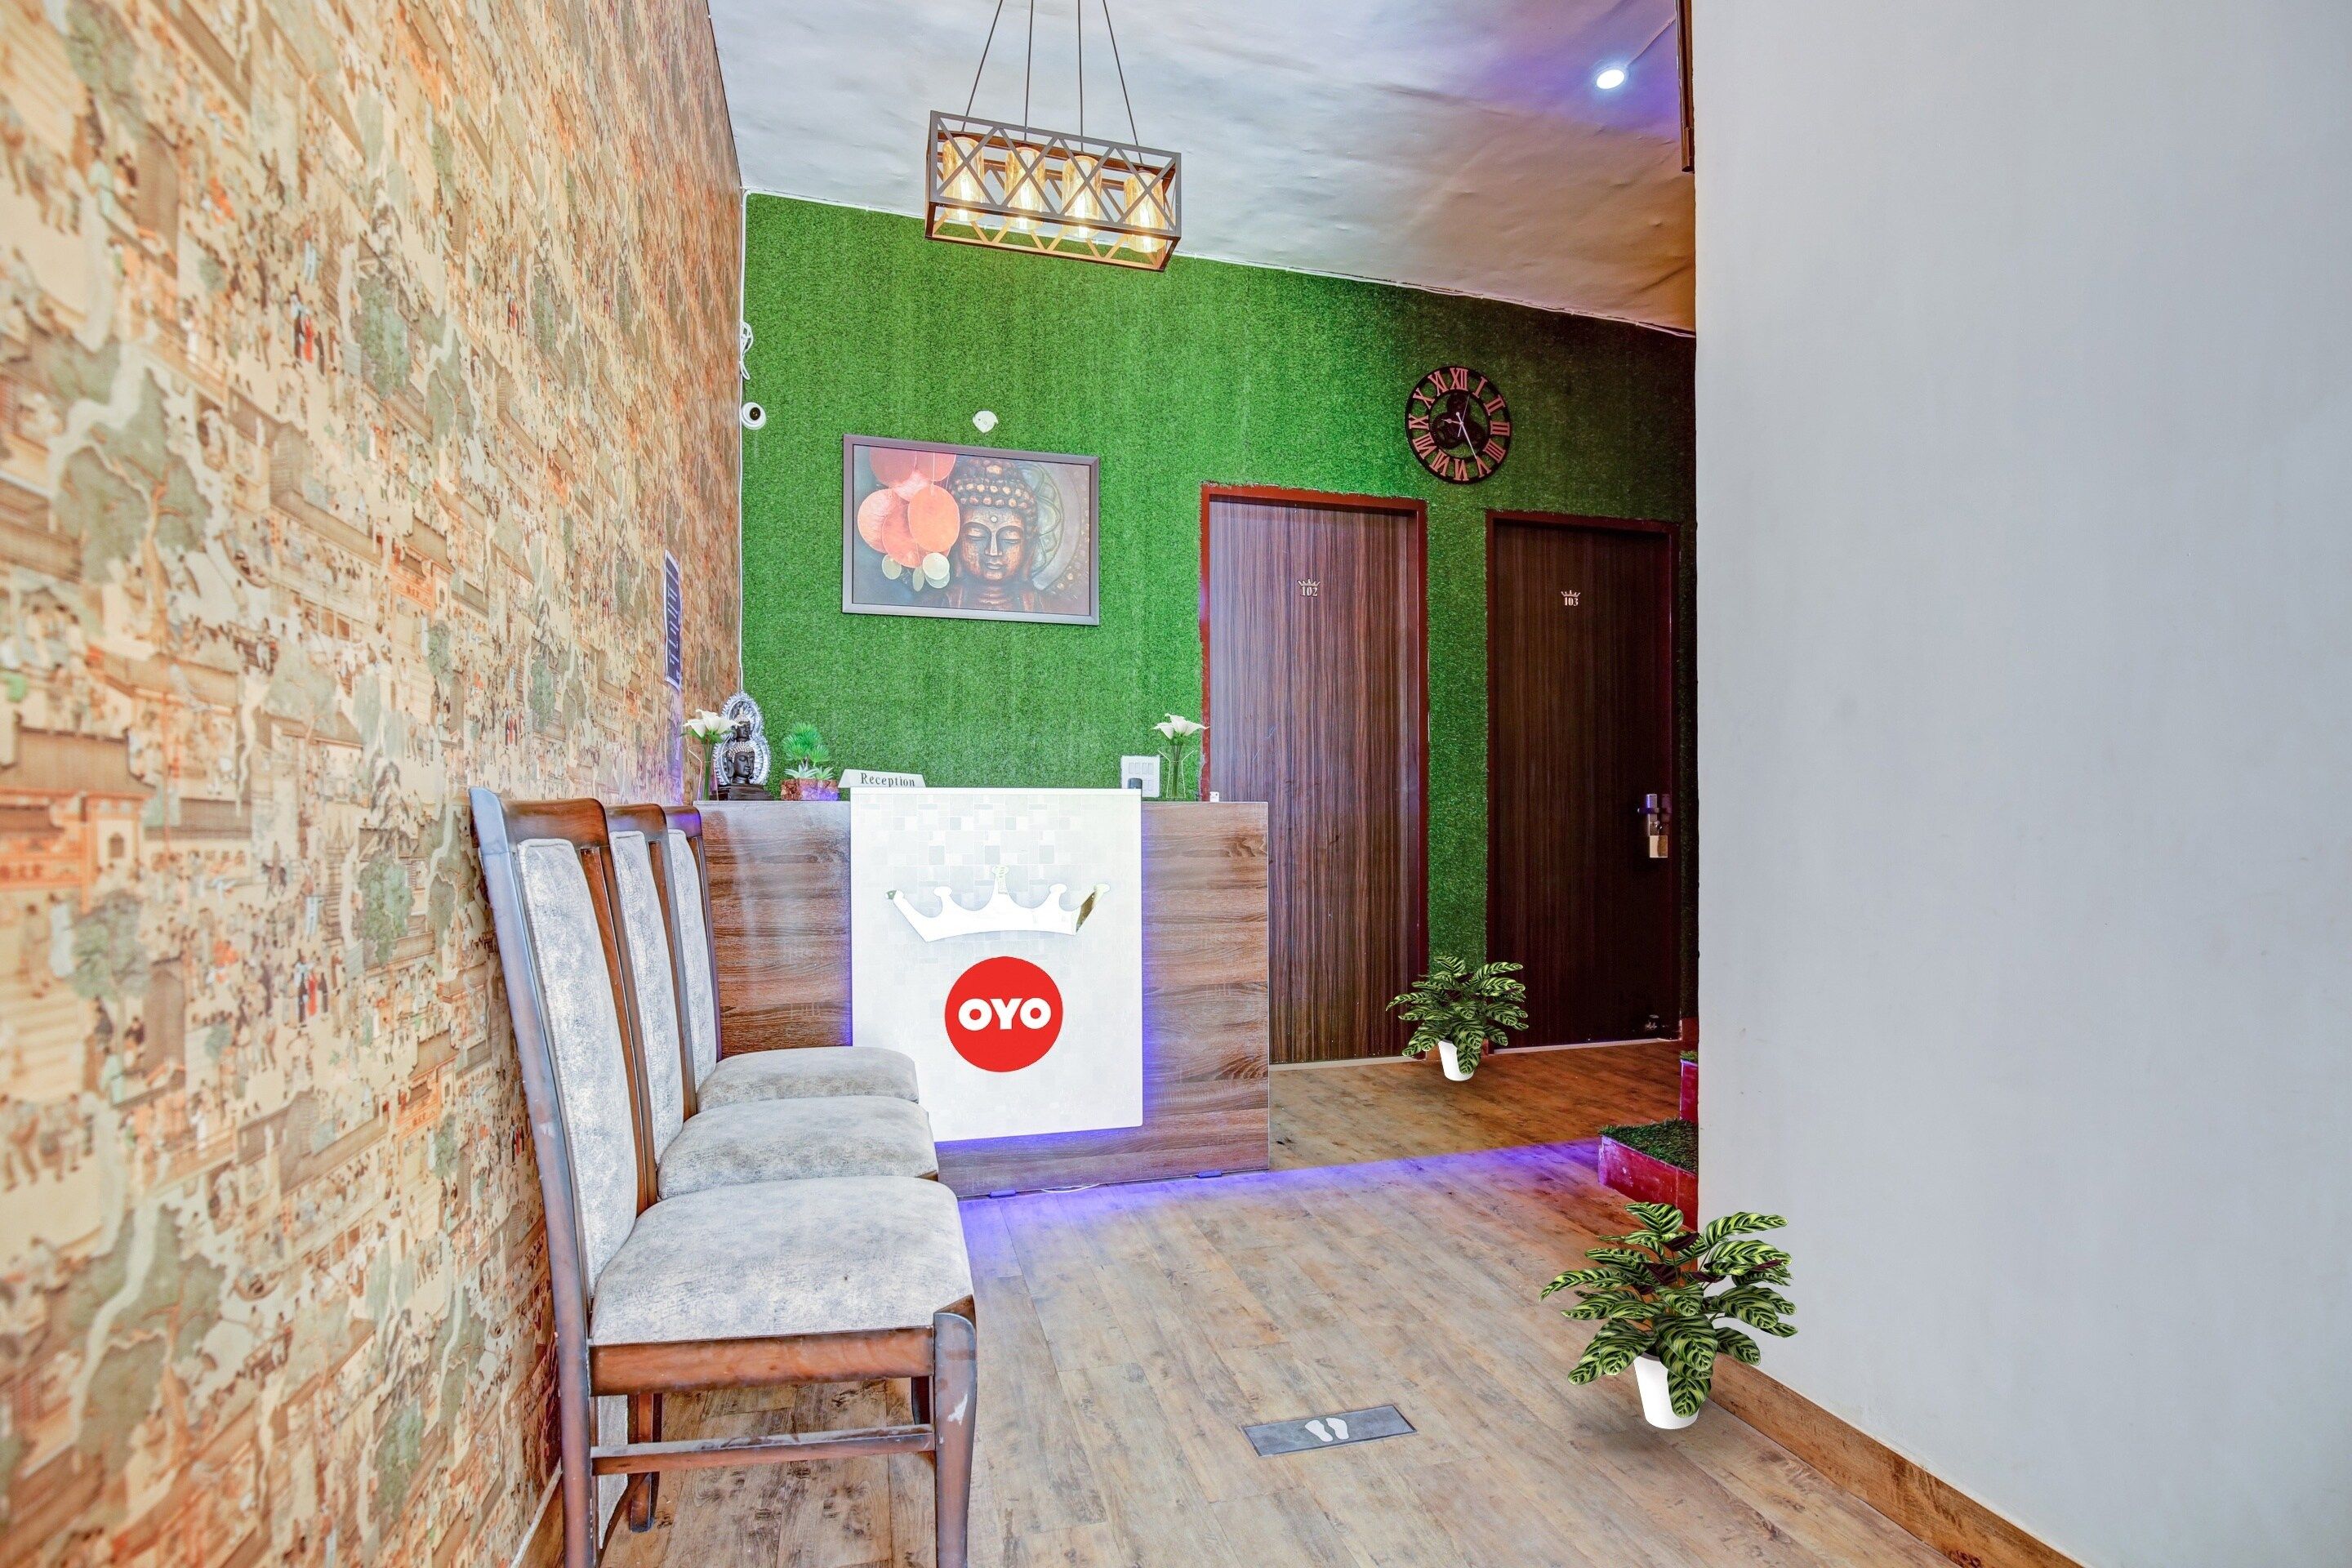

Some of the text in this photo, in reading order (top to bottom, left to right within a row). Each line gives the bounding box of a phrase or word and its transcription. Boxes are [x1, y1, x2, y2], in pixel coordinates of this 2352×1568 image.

[1428, 370, 1450, 397] XI
[1450, 368, 1468, 391] XII
[1472, 376, 1488, 398] I
[1412, 387, 1435, 410] X
[1483, 394, 1506, 416] II
[1408, 413, 1430, 430] IX
[1490, 420, 1510, 437] III
[1412, 432, 1437, 460] VIII
[1429, 448, 1450, 477] VII
[1454, 458, 1469, 481] VI
[1476, 455, 1492, 478] V
[1300, 586, 1318, 597] 102
[1564, 596, 1579, 607] 103
[860, 773, 915, 787] Reception
[958, 997, 1051, 1031] OYO
